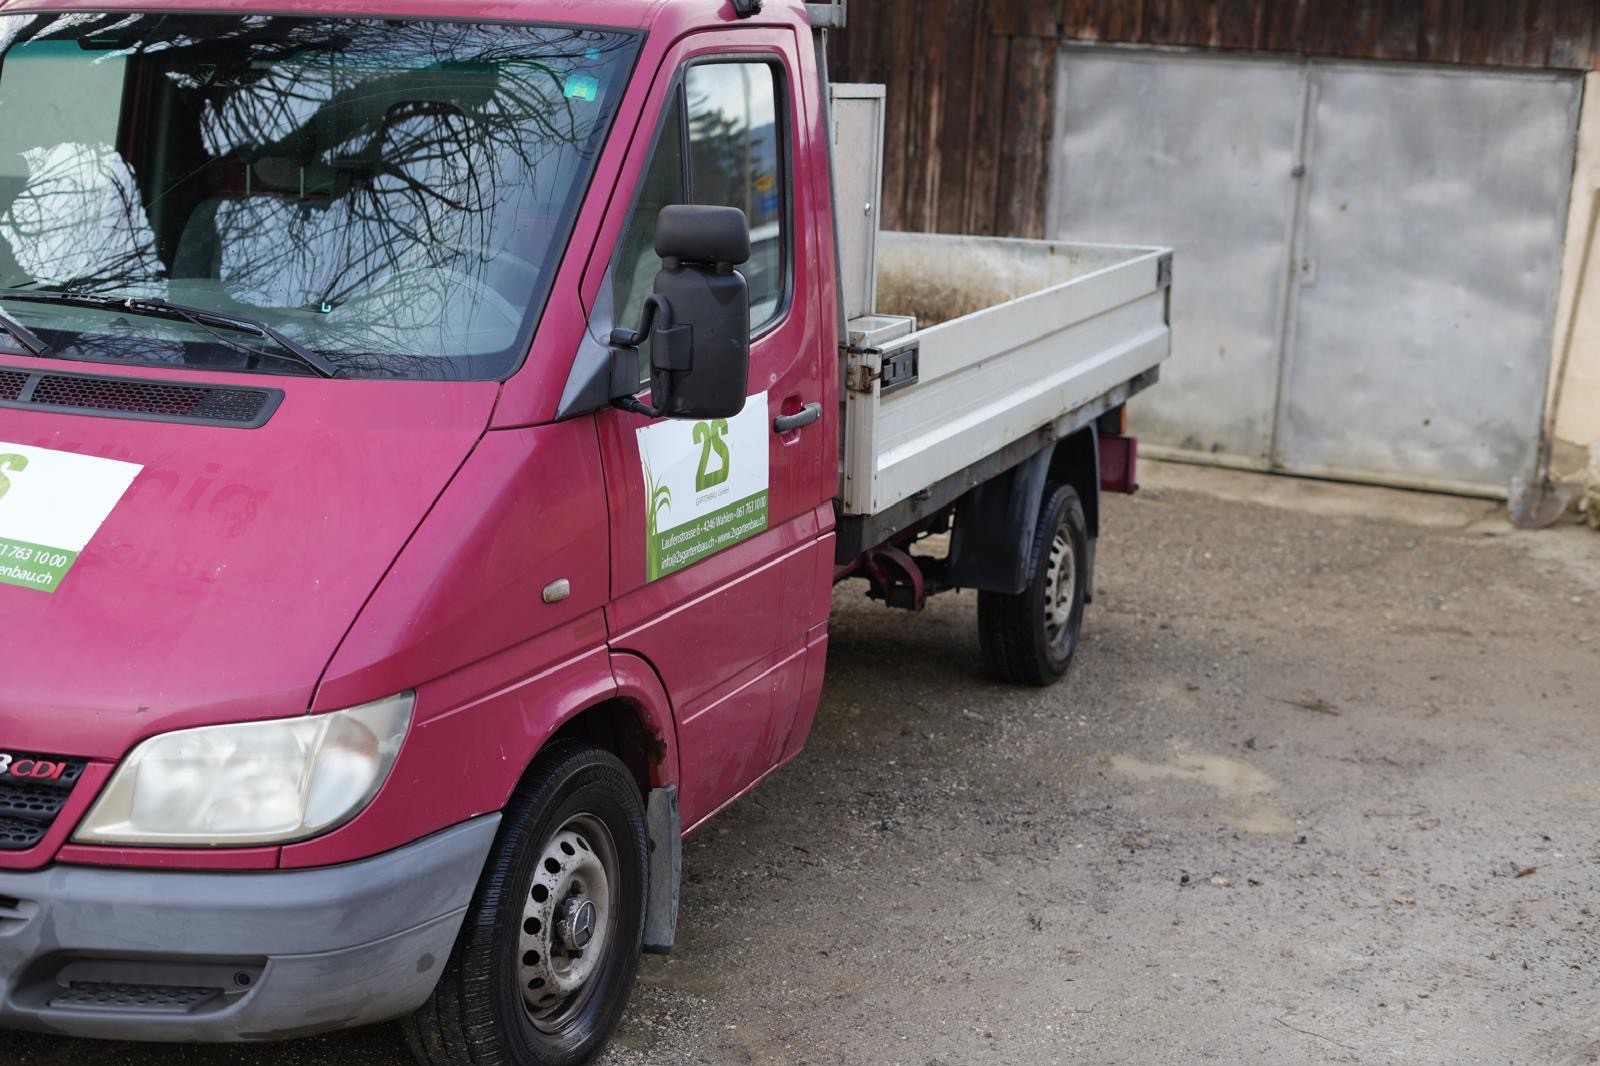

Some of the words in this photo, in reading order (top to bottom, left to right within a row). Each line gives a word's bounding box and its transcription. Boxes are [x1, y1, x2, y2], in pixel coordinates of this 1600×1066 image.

[692, 418, 730, 493] 2S
[661, 529, 696, 550] Laufenstrasse
[696, 525, 701, 536] 6
[703, 519, 716, 532] 4246
[715, 511, 734, 527] Wahlen
[736, 505, 745, 519] 061
[746, 500, 754, 514] 763
[661, 536, 715, 570] info@2sgartenbau.ch
[717, 513, 766, 545] www.2sgartenbau.ch
[0, 543, 9, 556] 1
[8, 546, 33, 560] 763
[33, 551, 50, 565] 10
[49, 554, 67, 568] 00
[0, 565, 53, 585] enbau.ch
[10, 759, 66, 779] CDI
